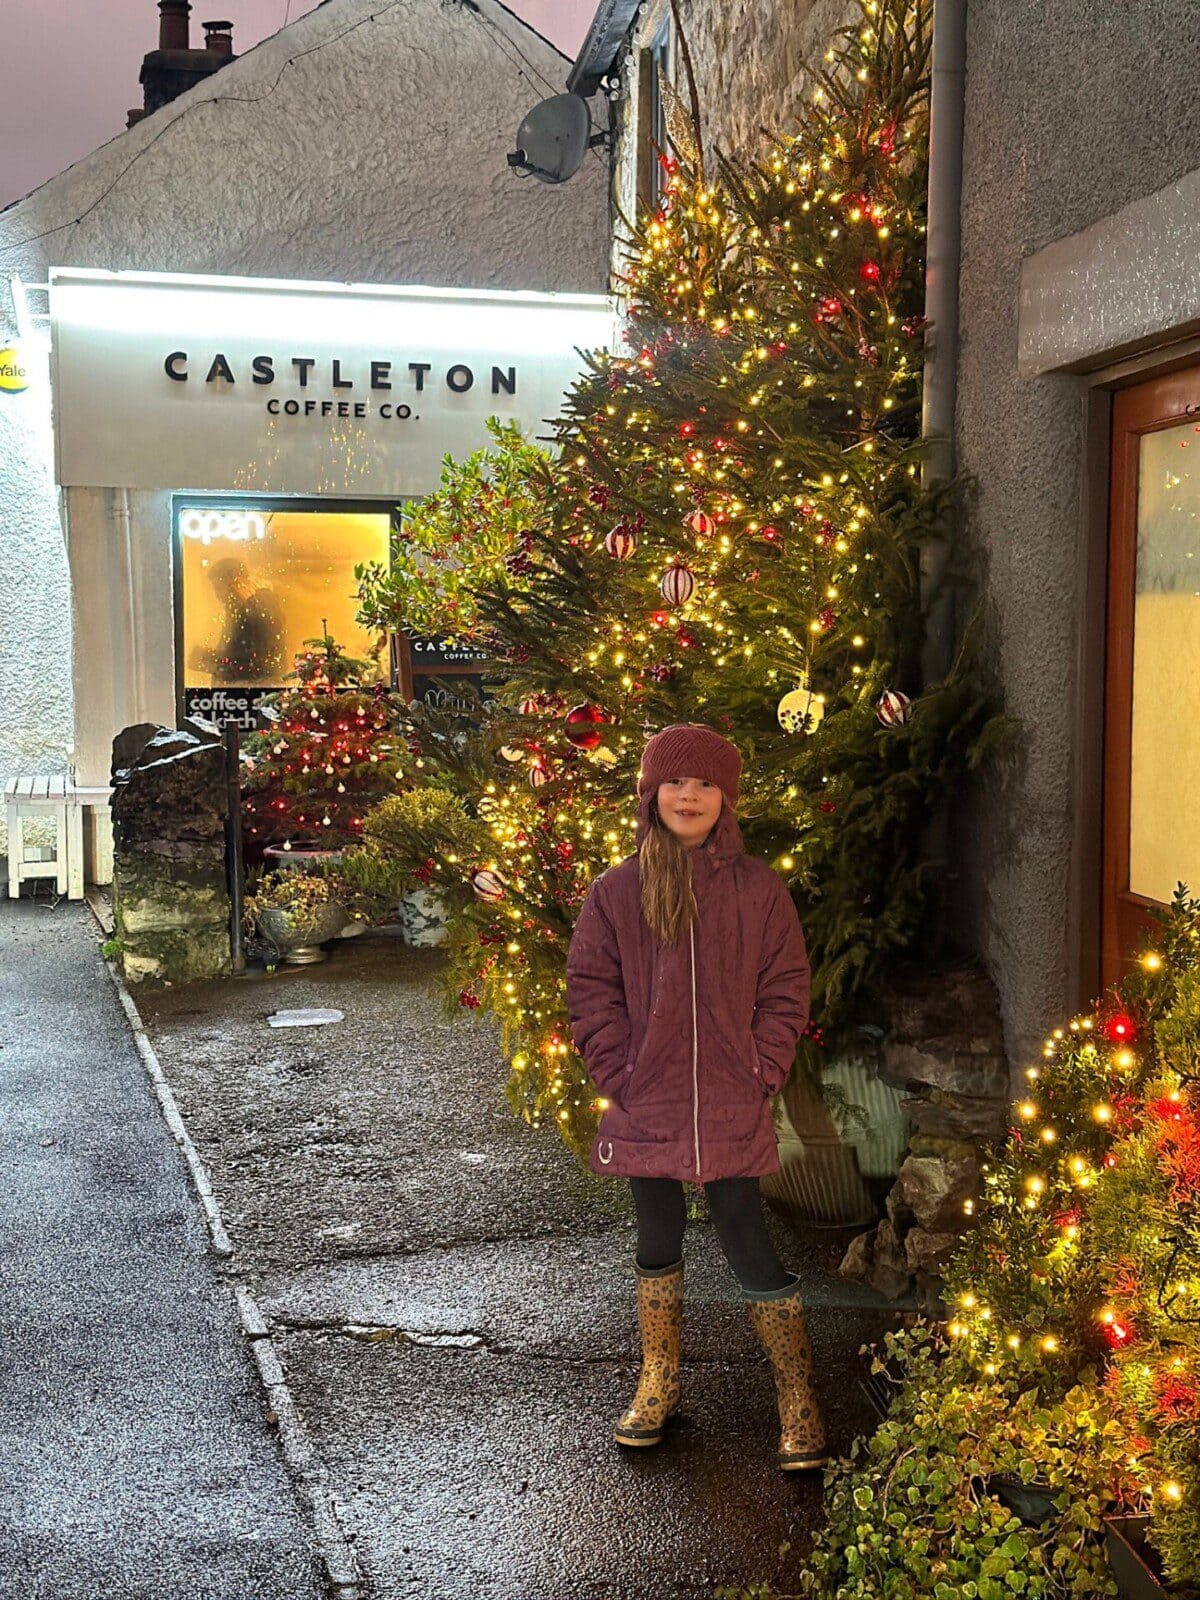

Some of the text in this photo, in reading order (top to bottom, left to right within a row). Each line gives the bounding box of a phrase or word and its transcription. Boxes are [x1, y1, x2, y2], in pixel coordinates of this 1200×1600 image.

[0, 364, 26, 377] Yale
[164, 352, 516, 394] CASTLETON
[267, 399, 420, 420] COFFEE CO.
[179, 509, 266, 545] open
[190, 692, 248, 711] coffee
